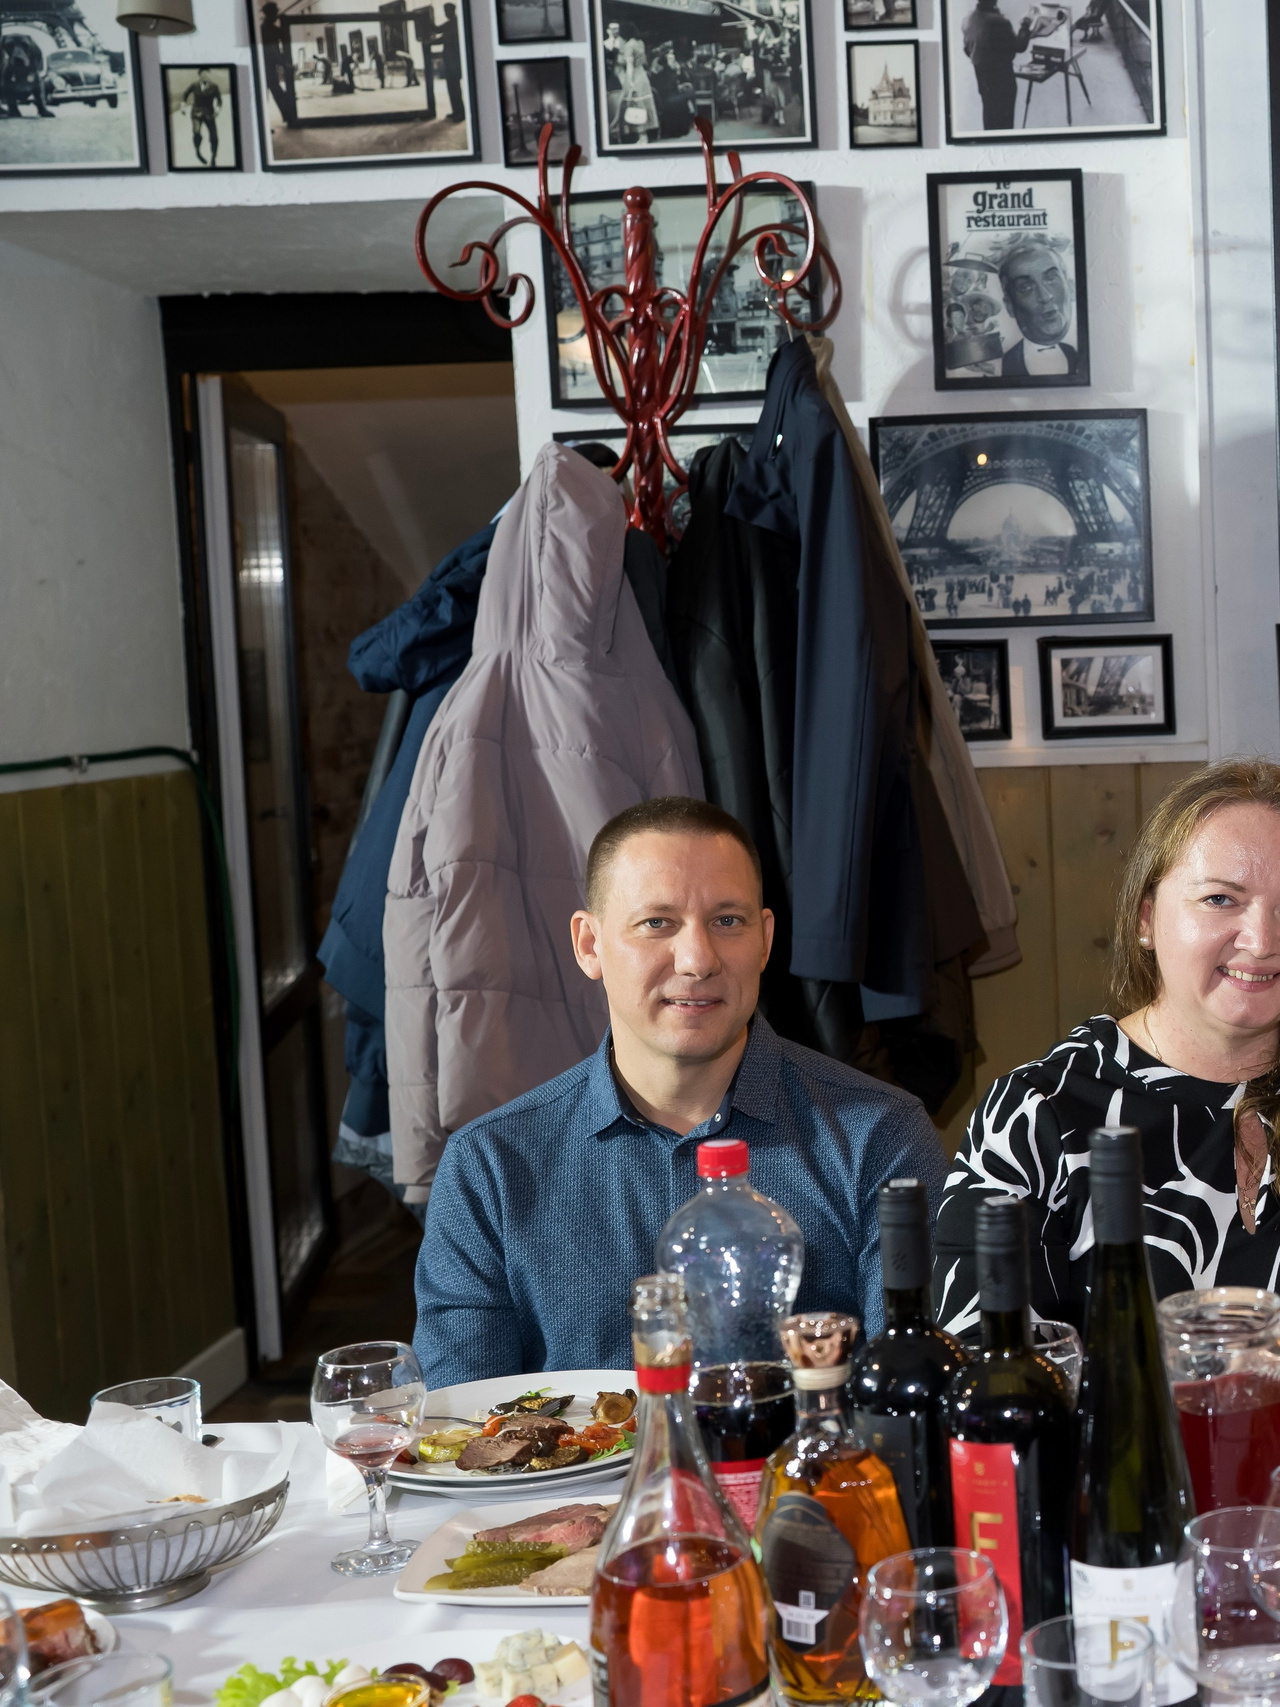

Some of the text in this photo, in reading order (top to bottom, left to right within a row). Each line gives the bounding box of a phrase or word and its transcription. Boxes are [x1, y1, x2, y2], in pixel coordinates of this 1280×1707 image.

[966, 210, 1048, 229] restaurant
[973, 187, 1034, 213] grand
[969, 1511, 1003, 1577] F
[1109, 1615, 1149, 1670] F
